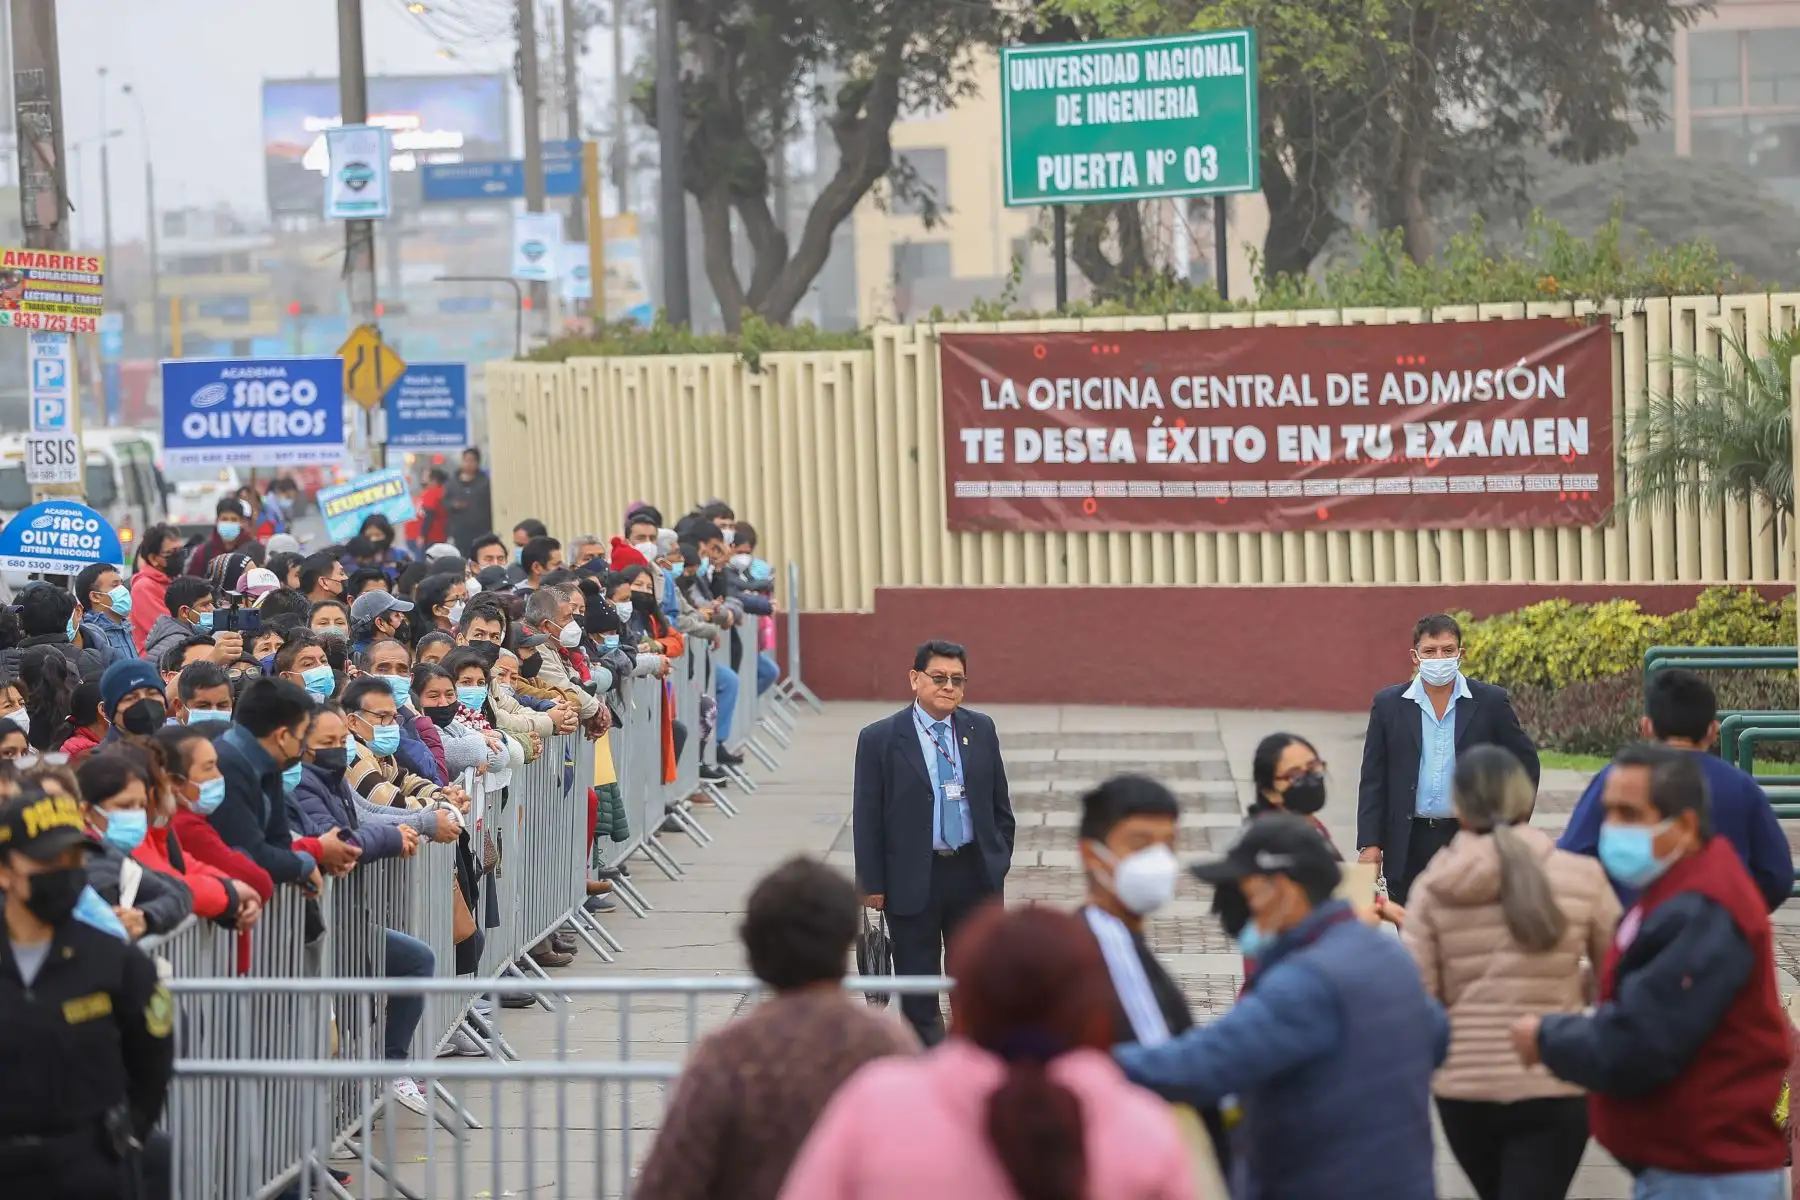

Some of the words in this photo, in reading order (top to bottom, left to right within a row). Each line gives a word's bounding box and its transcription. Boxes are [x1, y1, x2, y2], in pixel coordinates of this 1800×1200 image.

[1010, 52, 1140, 91] UNIVERSIDAD
[1145, 42, 1244, 81] NACIONAL
[1056, 94, 1082, 127] DE
[1086, 85, 1199, 124] INGENIERIA
[1037, 151, 1139, 191] PUERTA
[1183, 144, 1219, 183] 03
[3, 251, 99, 272] AMARRES
[14, 312, 40, 329] 933
[44, 314, 67, 332] 725
[71, 316, 96, 333] 454
[220, 367, 288, 379] ACADEMIA
[981, 377, 1020, 410] LA
[1027, 376, 1165, 410] OFICINA
[1170, 374, 1319, 409] CENTRAL
[1326, 372, 1370, 406] DE
[1378, 357, 1565, 405] ADMISIÓN
[233, 379, 318, 408] SACO
[182, 409, 327, 440] OLIVEROS
[960, 428, 1004, 464] TE
[1014, 427, 1137, 464] DESEA
[1146, 415, 1267, 464] ÉXITO
[1276, 424, 1331, 463] EN
[1340, 424, 1393, 461] TU
[1403, 417, 1589, 459] EXAMEN
[28, 439, 76, 465] TESIS
[44, 507, 83, 517] ACADEMIA
[53, 516, 99, 533] SACO
[20, 545, 53, 554] SISTEMA
[21, 529, 102, 550] OLIVEROS
[7, 559, 25, 568] 680
[28, 561, 51, 569] 5300
[62, 563, 80, 572] 997
